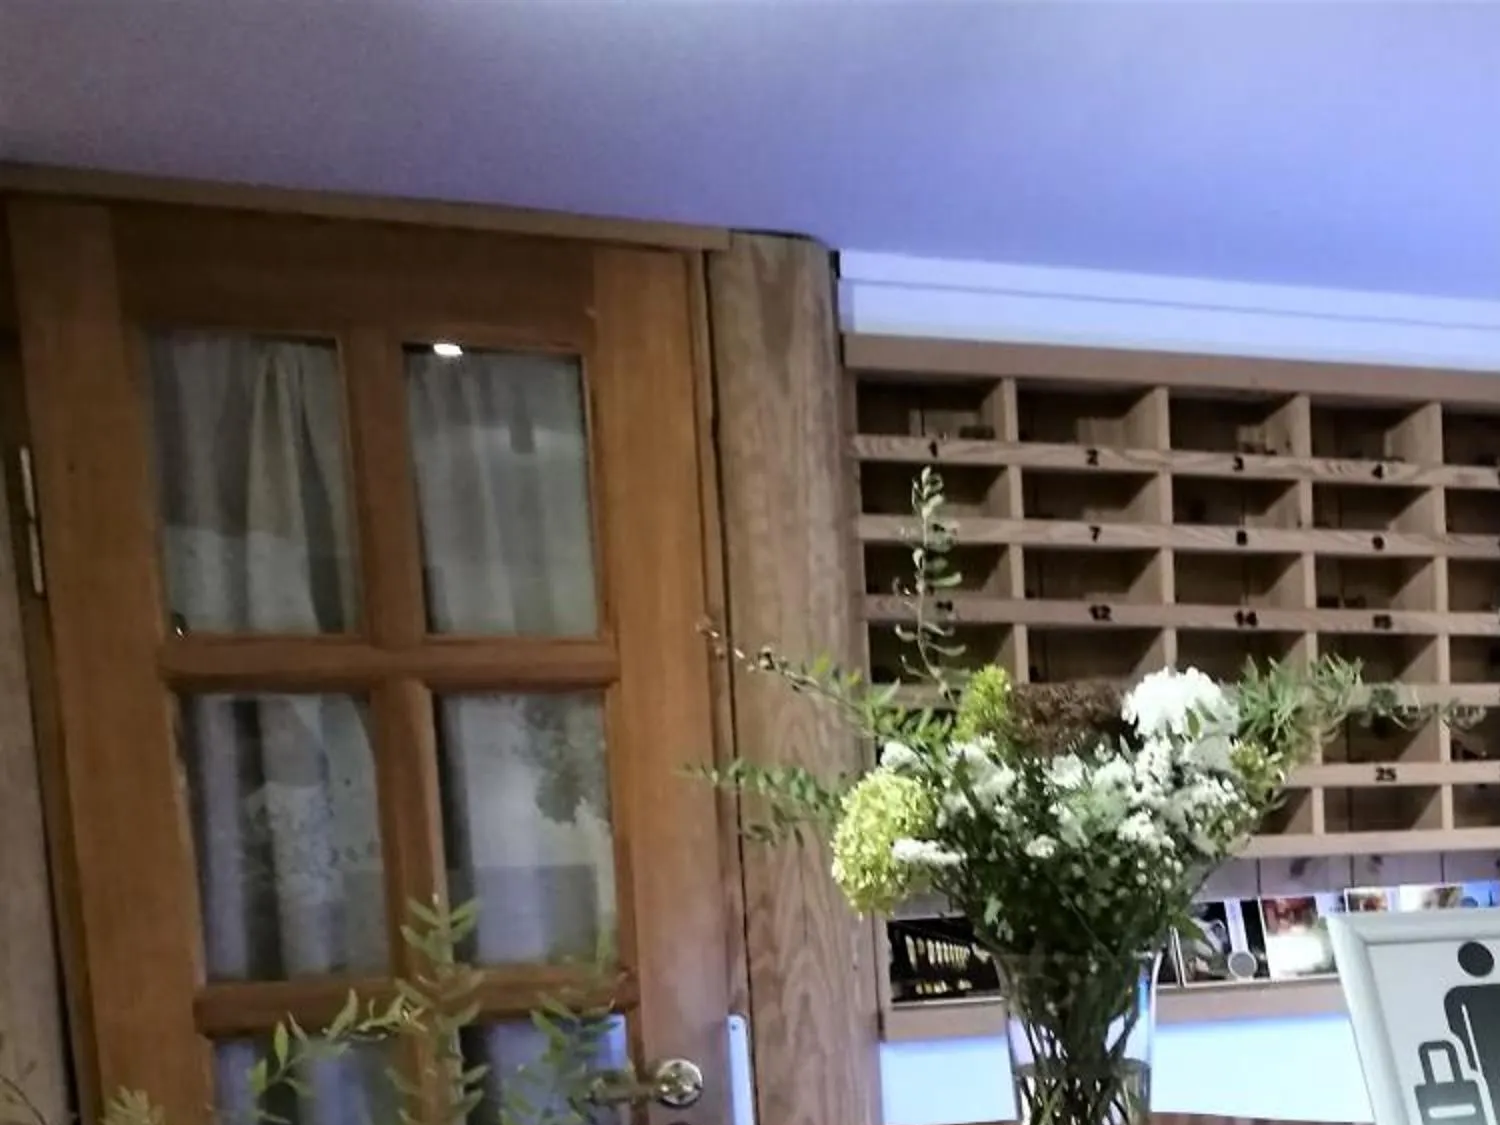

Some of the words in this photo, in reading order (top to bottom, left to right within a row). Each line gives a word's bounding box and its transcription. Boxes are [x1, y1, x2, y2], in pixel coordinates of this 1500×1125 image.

[1086, 448, 1098, 466] 2
[1233, 455, 1244, 472] 3
[1089, 525, 1100, 542] 7
[1089, 604, 1111, 621] 12
[1375, 767, 1396, 782] 25
